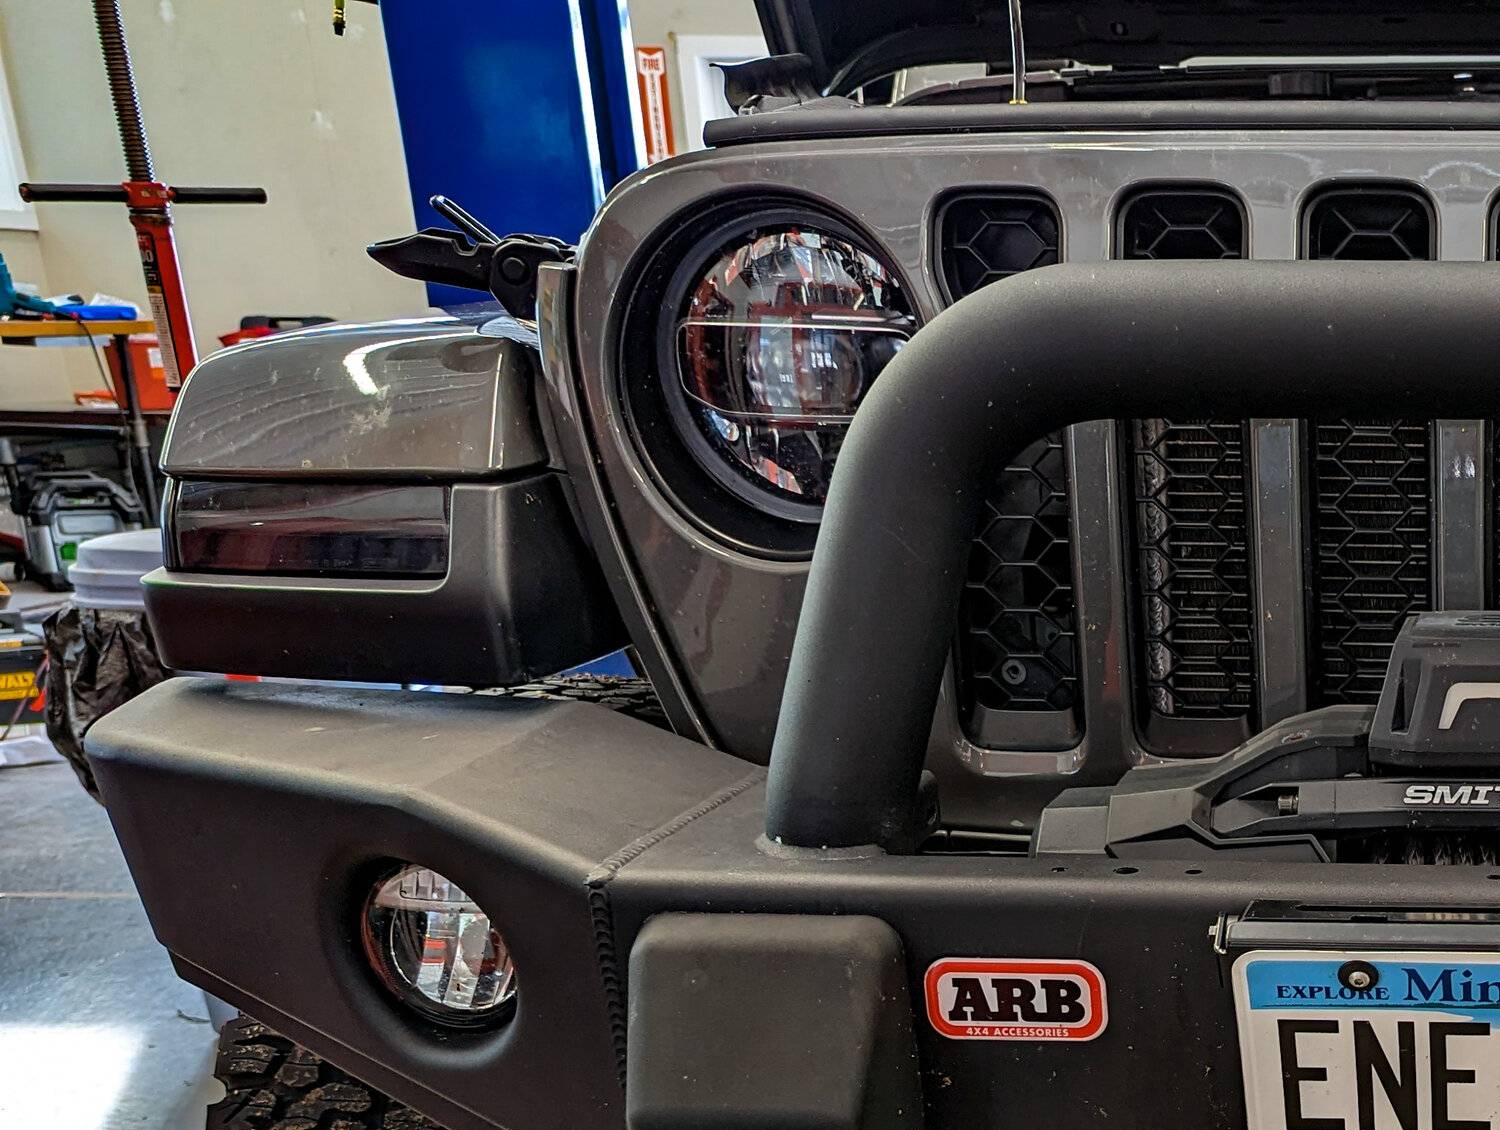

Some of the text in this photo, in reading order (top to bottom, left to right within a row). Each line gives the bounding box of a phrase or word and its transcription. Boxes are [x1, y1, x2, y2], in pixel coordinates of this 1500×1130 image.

[948, 977, 1086, 1022] ARB
[1276, 985, 1389, 1001] EXPLORE
[966, 1027, 1070, 1038] 4X4 ACCESSORIES
